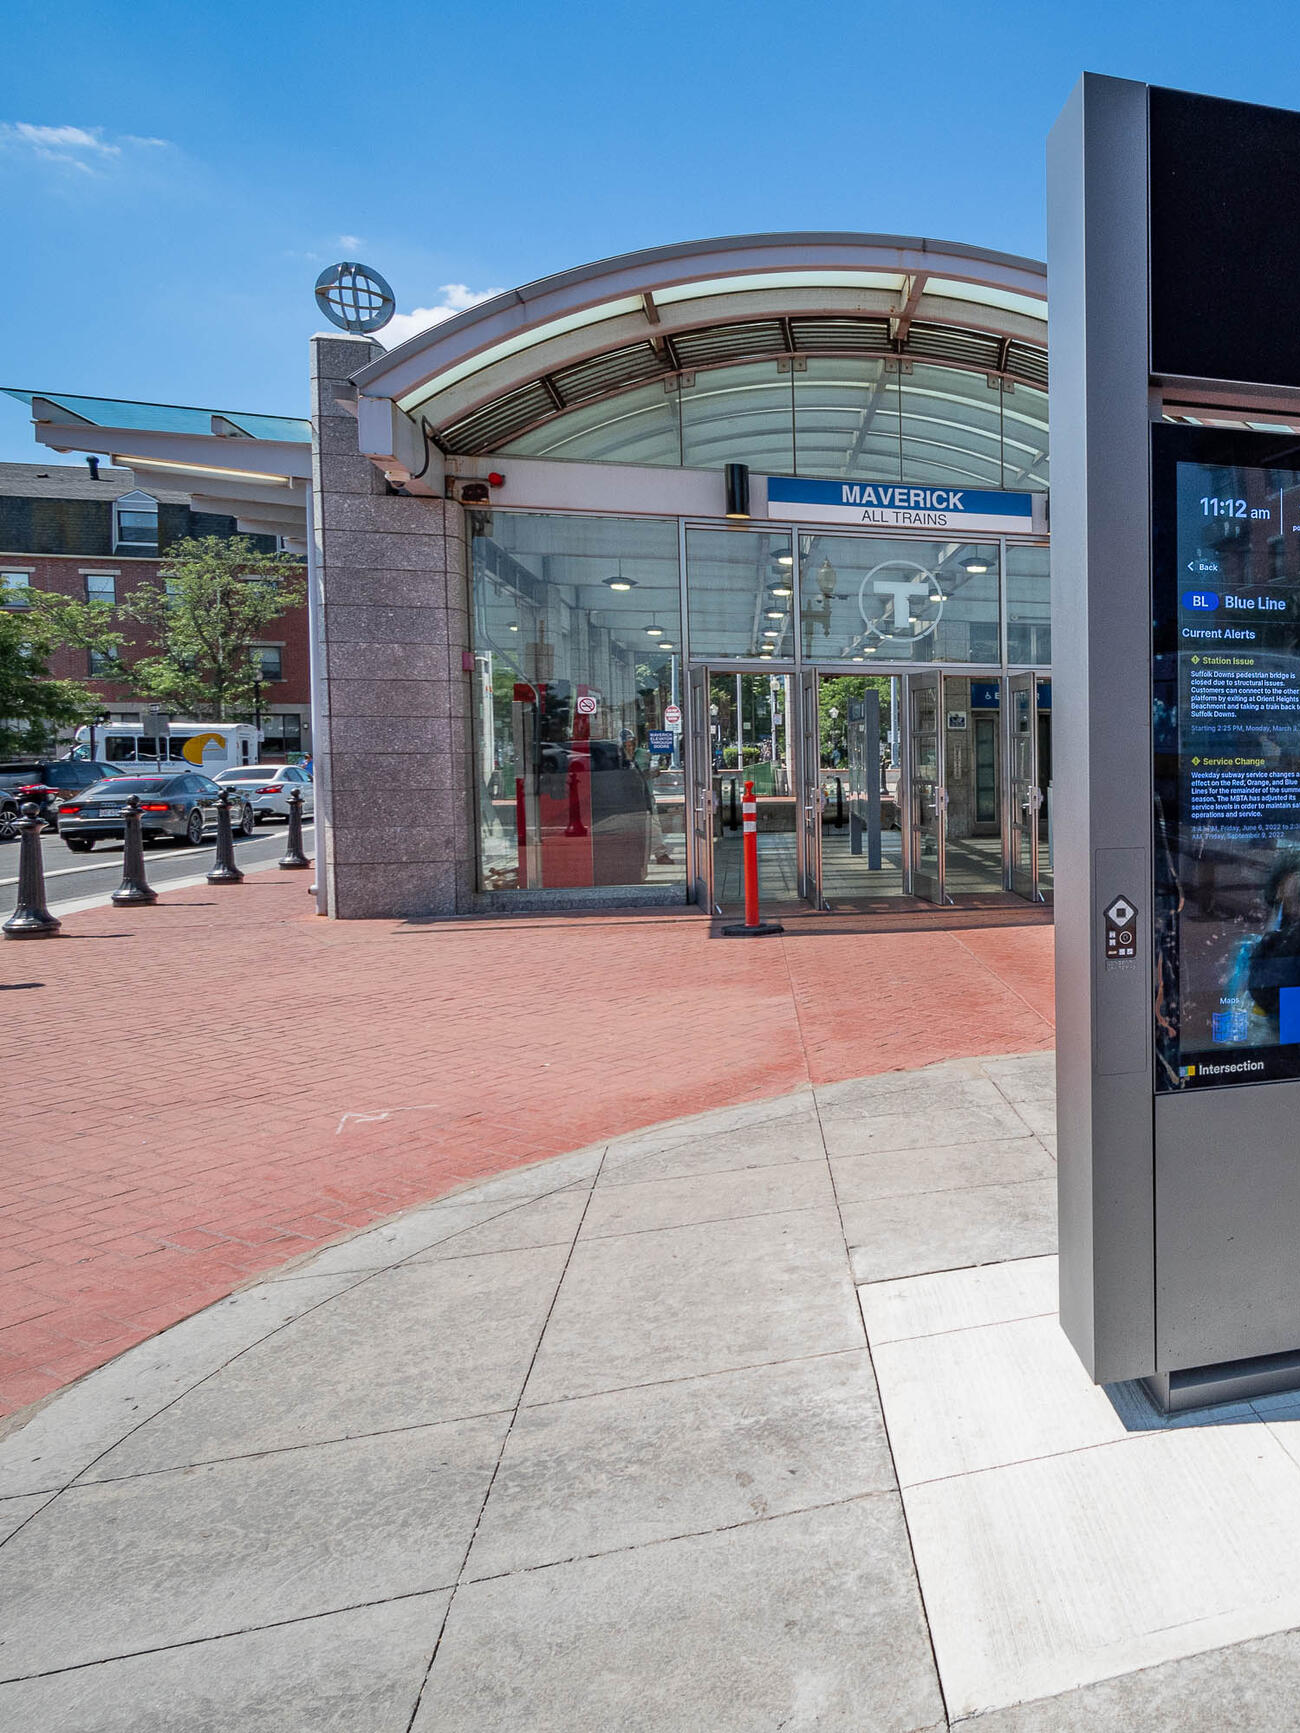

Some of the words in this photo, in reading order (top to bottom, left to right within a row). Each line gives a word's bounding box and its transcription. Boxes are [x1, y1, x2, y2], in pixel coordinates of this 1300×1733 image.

[842, 485, 965, 510] MAVERICK
[1200, 497, 1247, 518] 11:12
[1250, 509, 1270, 519] am
[861, 509, 889, 523] ALL
[892, 511, 947, 526] TRAINS
[1199, 563, 1218, 571] Back
[873, 581, 929, 627] T
[1192, 595, 1209, 607] BL
[1225, 595, 1255, 609] Blue
[1258, 597, 1287, 610] Line
[1182, 628, 1221, 639] Current
[1223, 629, 1256, 640] Alerts
[1202, 656, 1231, 665] Station
[1233, 657, 1254, 665] Issue
[1203, 758, 1233, 766] Service
[1235, 758, 1265, 766] Change
[1219, 996, 1239, 1005] Maps
[1199, 1059, 1264, 1076] Intersection
